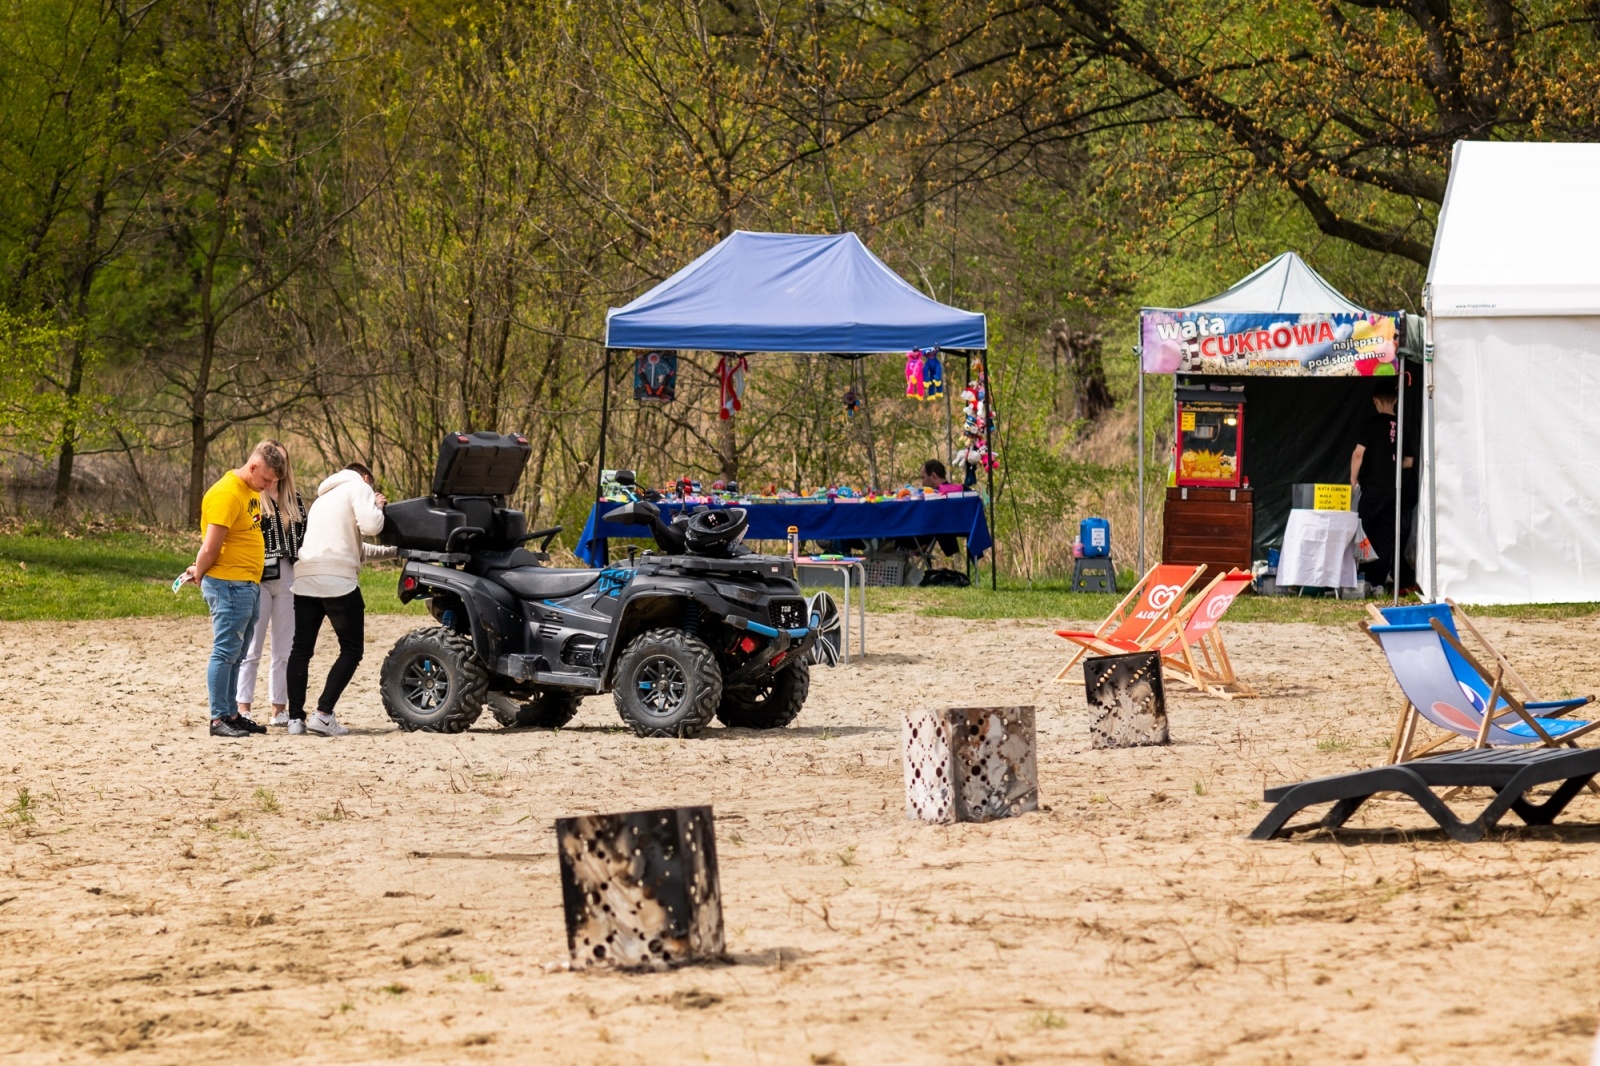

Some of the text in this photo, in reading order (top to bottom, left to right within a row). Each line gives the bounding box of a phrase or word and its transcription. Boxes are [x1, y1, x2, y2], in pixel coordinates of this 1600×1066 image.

[1156, 315, 1226, 341] wata
[1200, 321, 1336, 358] CUKROWA
[1332, 336, 1384, 351] najlepsze
[1249, 359, 1300, 371] popcorn
[1308, 356, 1329, 369] pod
[1135, 611, 1168, 620] ALGIA
